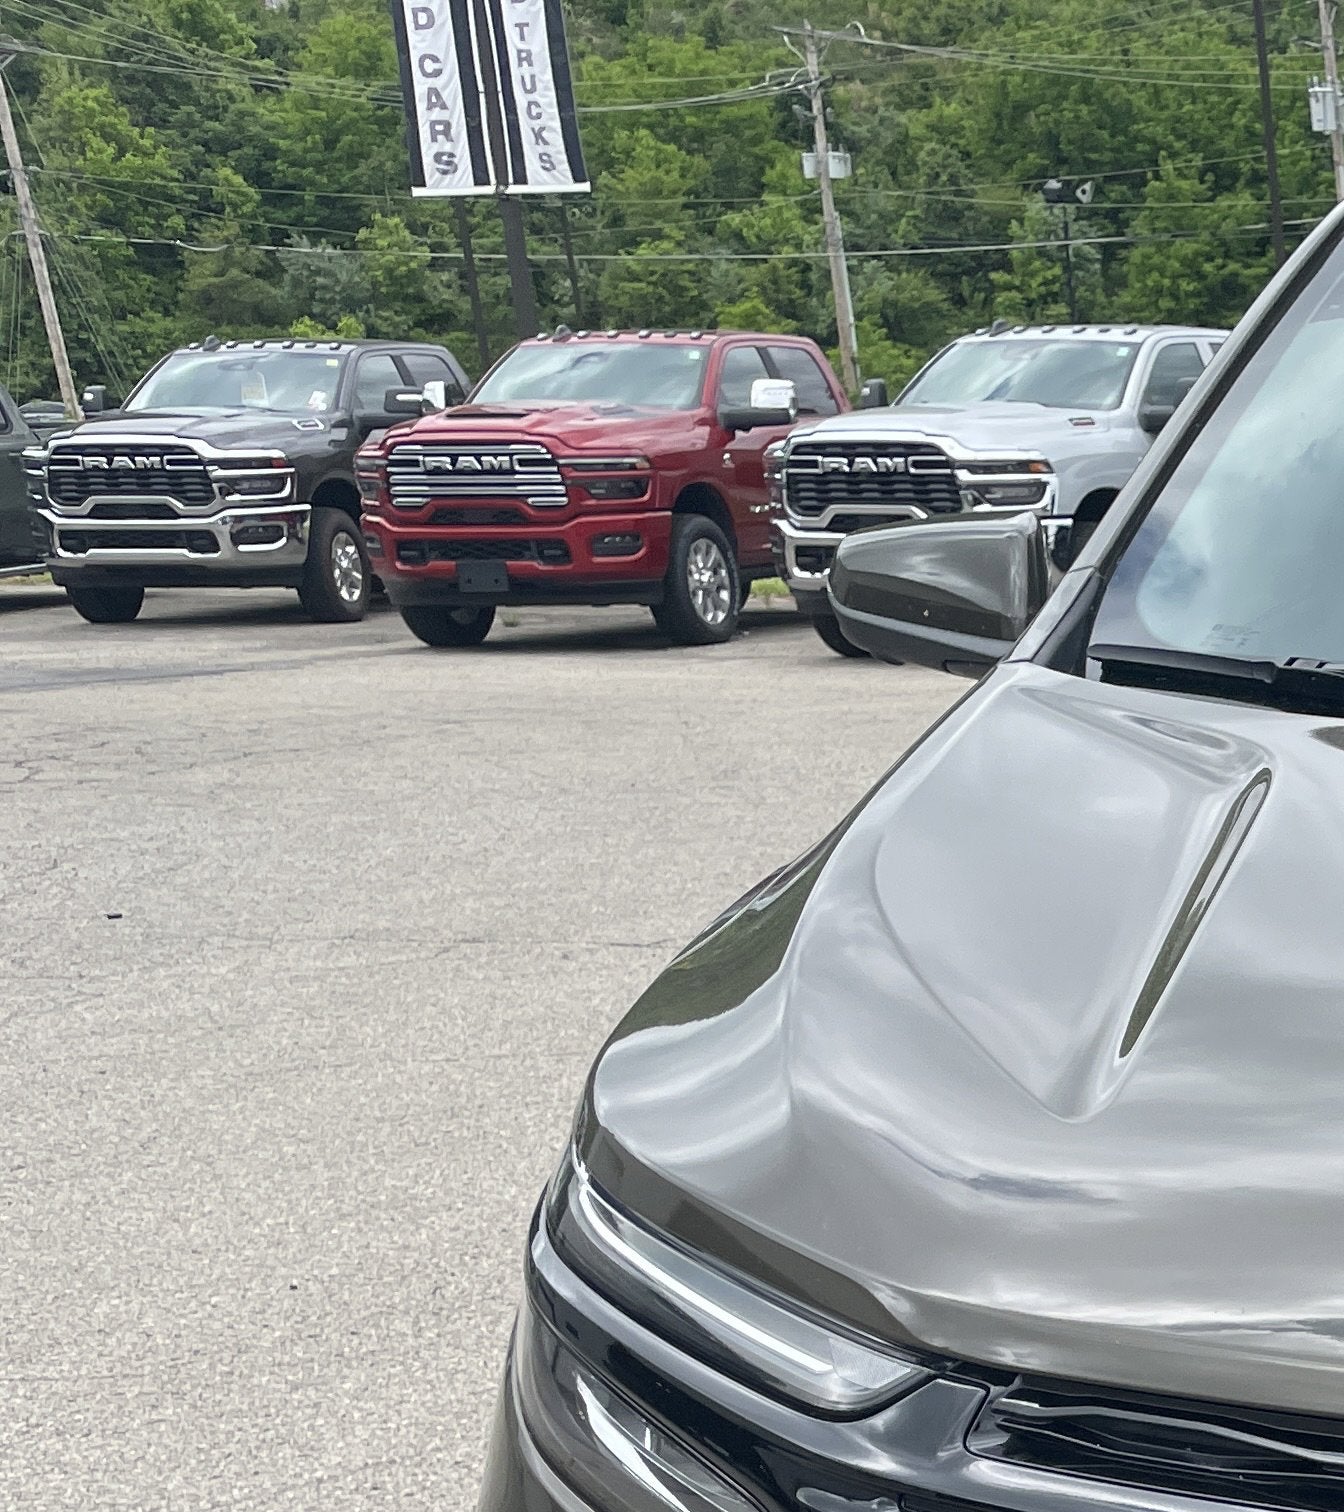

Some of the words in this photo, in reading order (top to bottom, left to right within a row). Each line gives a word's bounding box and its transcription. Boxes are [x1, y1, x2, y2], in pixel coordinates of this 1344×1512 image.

[514, 22, 556, 172] TRUCKS
[418, 53, 458, 175] CARS
[82, 456, 162, 469] RAM
[424, 456, 511, 471] RAM
[822, 456, 906, 472] RAM
